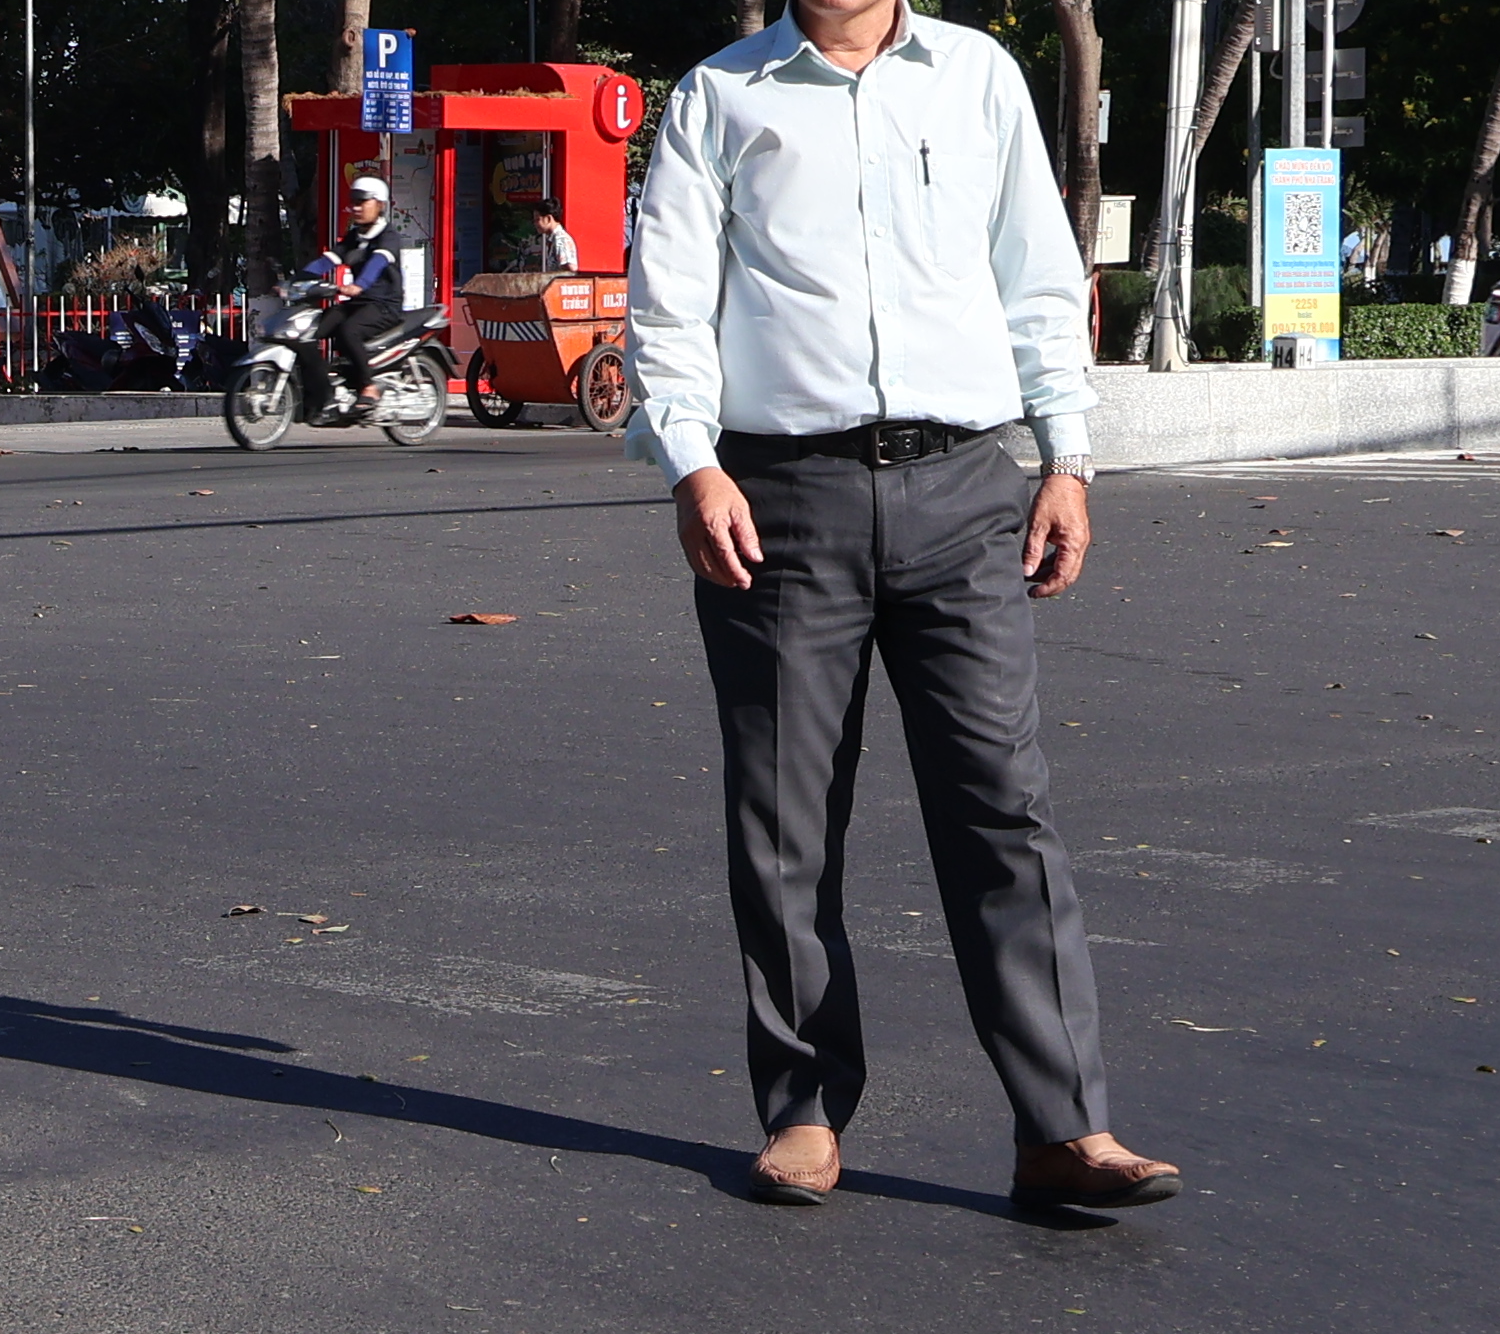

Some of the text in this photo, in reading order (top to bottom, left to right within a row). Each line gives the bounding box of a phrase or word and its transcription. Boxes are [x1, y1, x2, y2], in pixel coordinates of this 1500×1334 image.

[379, 33, 398, 68] P
[1275, 346, 1313, 368] H4 H4
